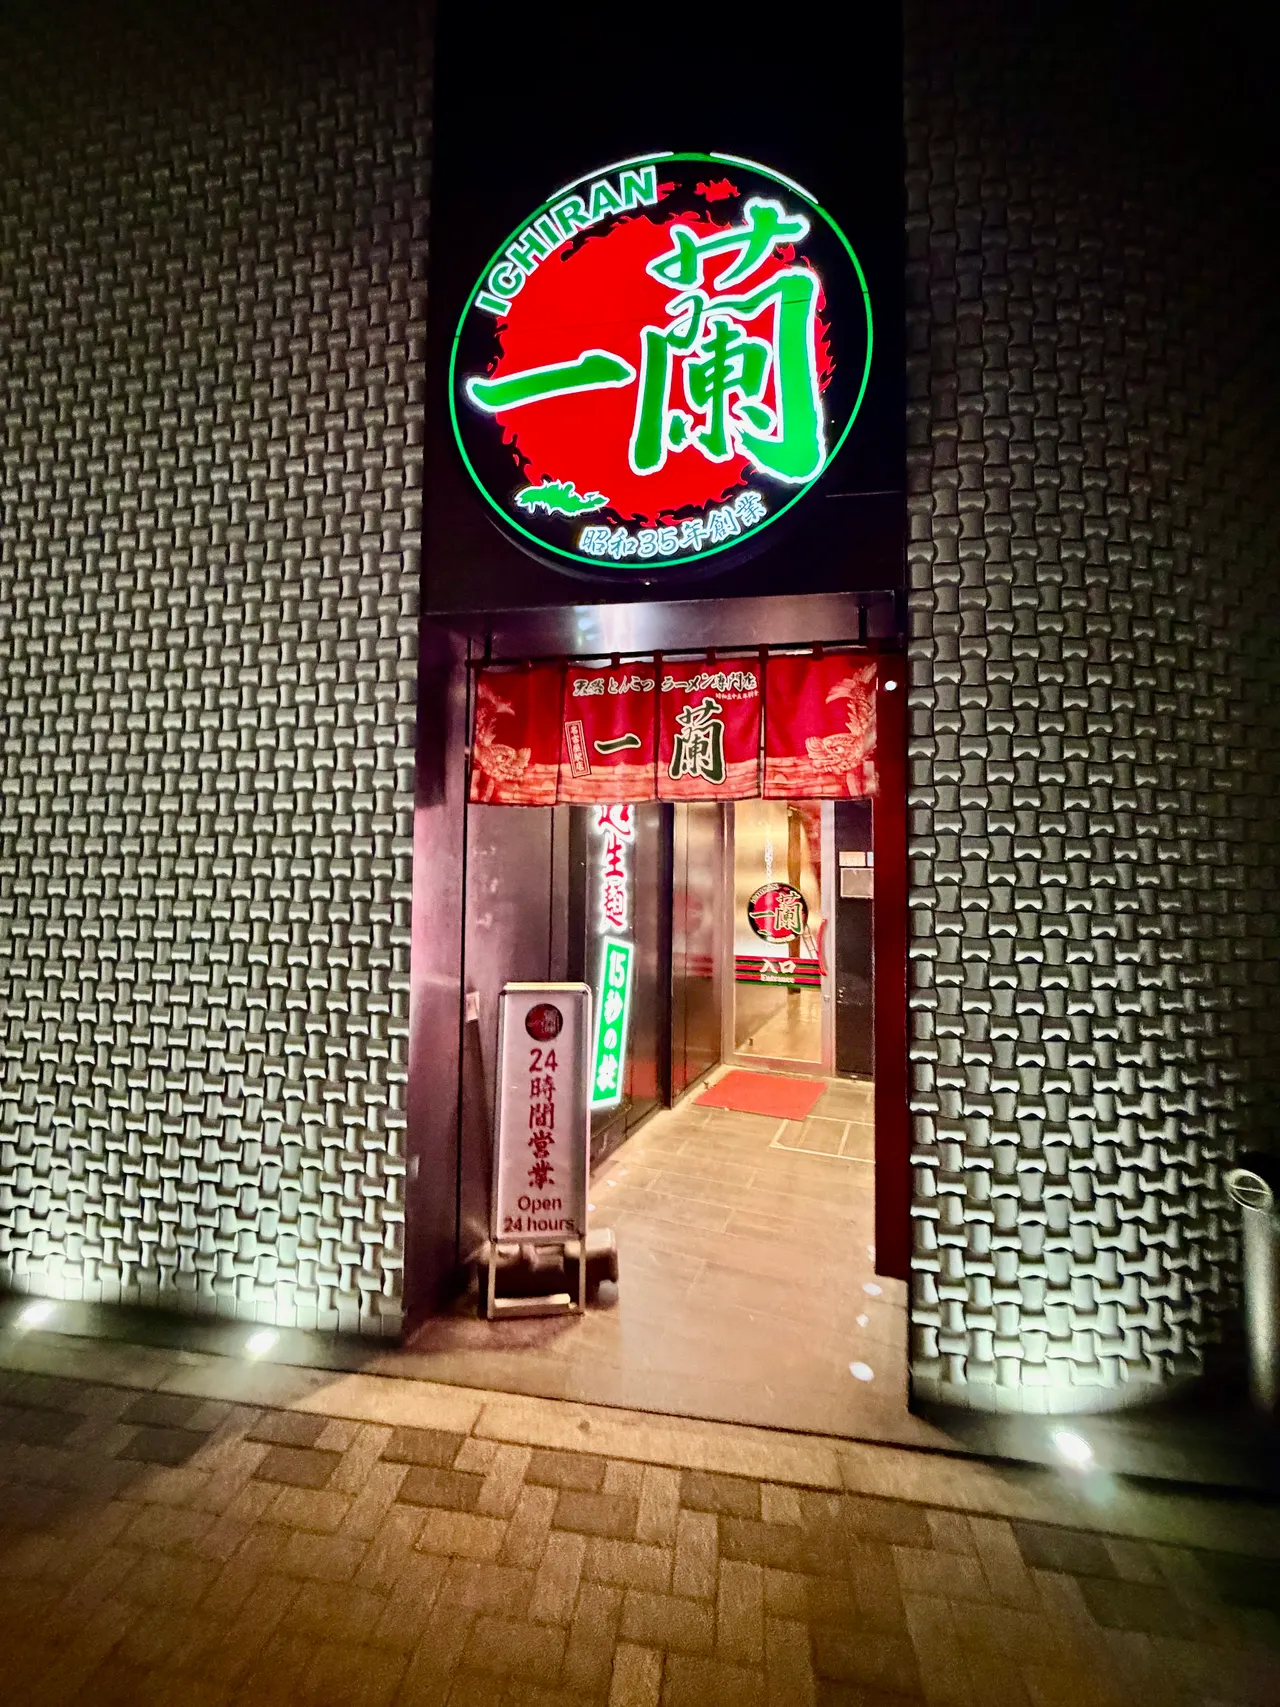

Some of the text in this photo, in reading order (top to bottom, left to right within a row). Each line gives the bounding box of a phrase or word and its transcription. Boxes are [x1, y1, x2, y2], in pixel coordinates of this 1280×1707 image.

[475, 166, 658, 316] ICHIRAN
[463, 197, 828, 484] 一蘭
[578, 491, 768, 560] 昭和35年創業
[594, 696, 727, 784] 一蘭
[750, 890, 803, 934] 一蘭
[759, 959, 796, 974] 入口
[503, 1216, 575, 1232] 24 hours
[518, 1195, 562, 1214] Open
